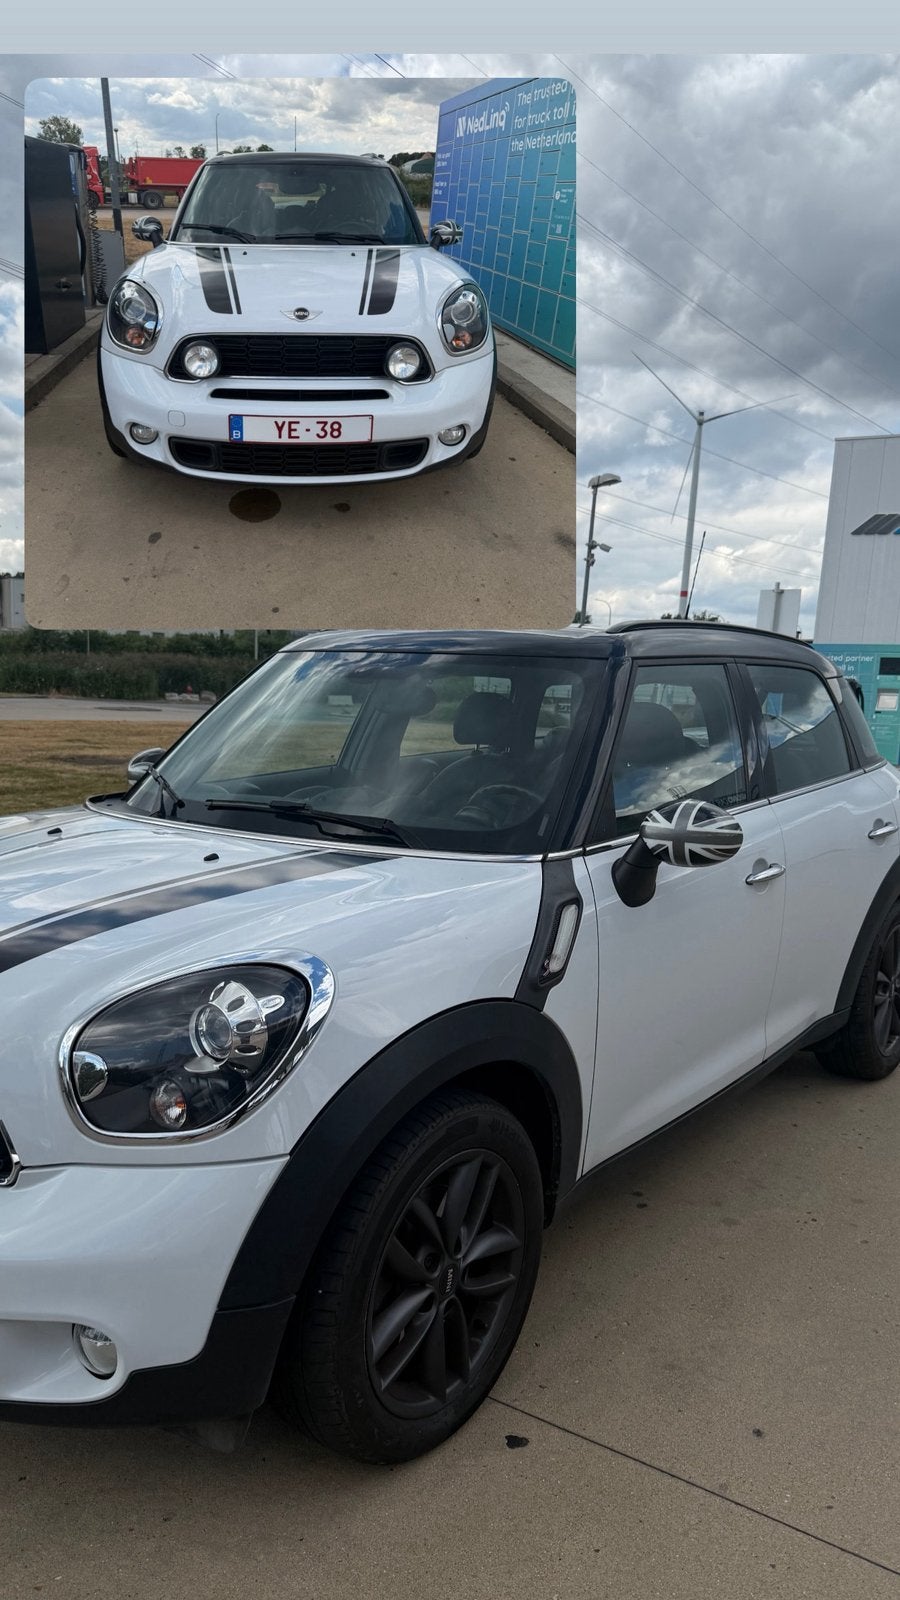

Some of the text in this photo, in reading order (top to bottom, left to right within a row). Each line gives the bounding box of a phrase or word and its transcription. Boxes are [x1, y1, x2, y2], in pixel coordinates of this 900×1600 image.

[518, 93, 531, 106] The
[534, 80, 568, 100] trusted
[466, 109, 506, 135] NedLinq
[514, 116, 526, 129] for
[528, 111, 551, 126] truck
[553, 102, 570, 120] toll
[511, 139, 524, 152] the
[232, 420, 342, 439] B YE-38
[446, 1268, 454, 1292] MINI
